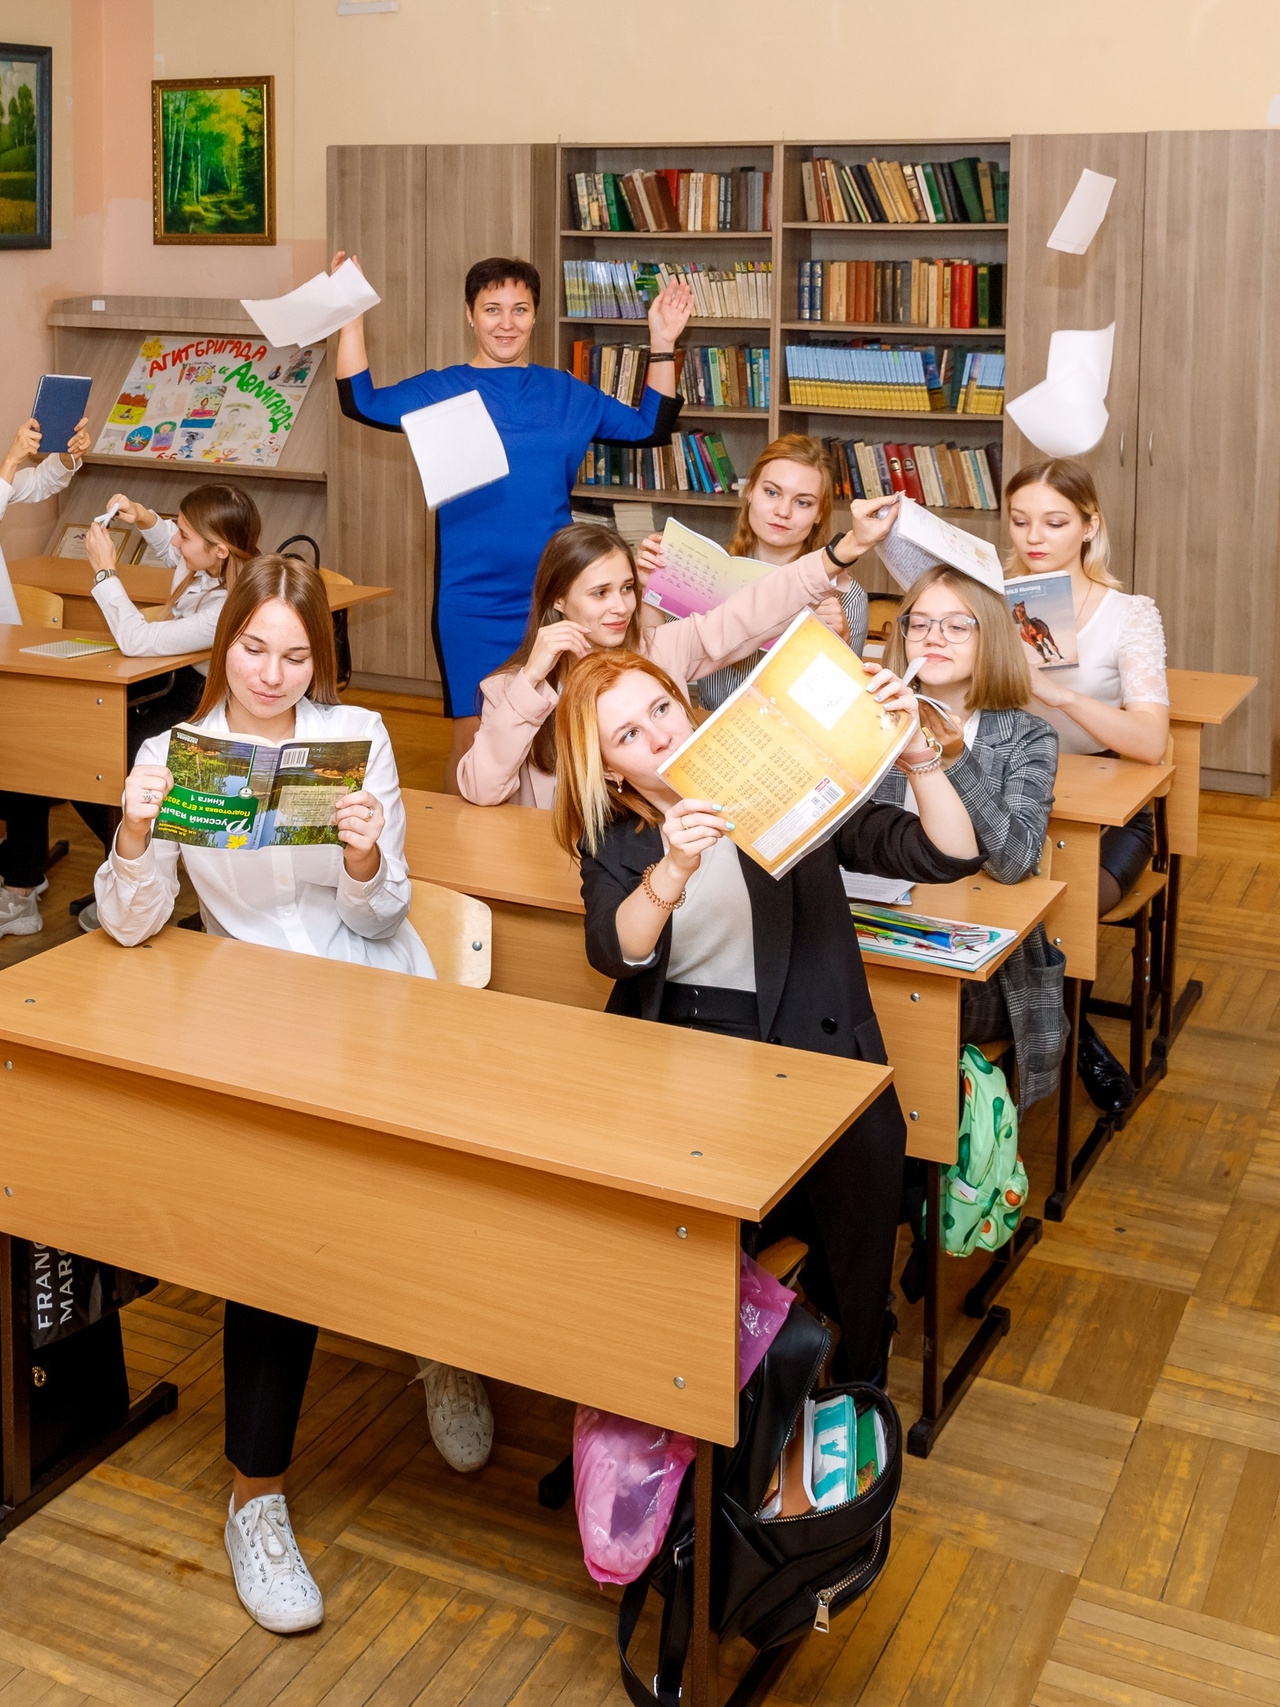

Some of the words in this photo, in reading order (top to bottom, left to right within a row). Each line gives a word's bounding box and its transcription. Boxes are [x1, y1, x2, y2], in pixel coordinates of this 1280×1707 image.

[149, 339, 268, 378] АГИТБРИГАДА
[190, 794, 196, 802] 1
[197, 796, 225, 806] Книга
[182, 801, 198, 811] ЕГЭ
[205, 806, 251, 817] Подготовка
[160, 806, 187, 819] язык
[189, 815, 251, 835] Русский
